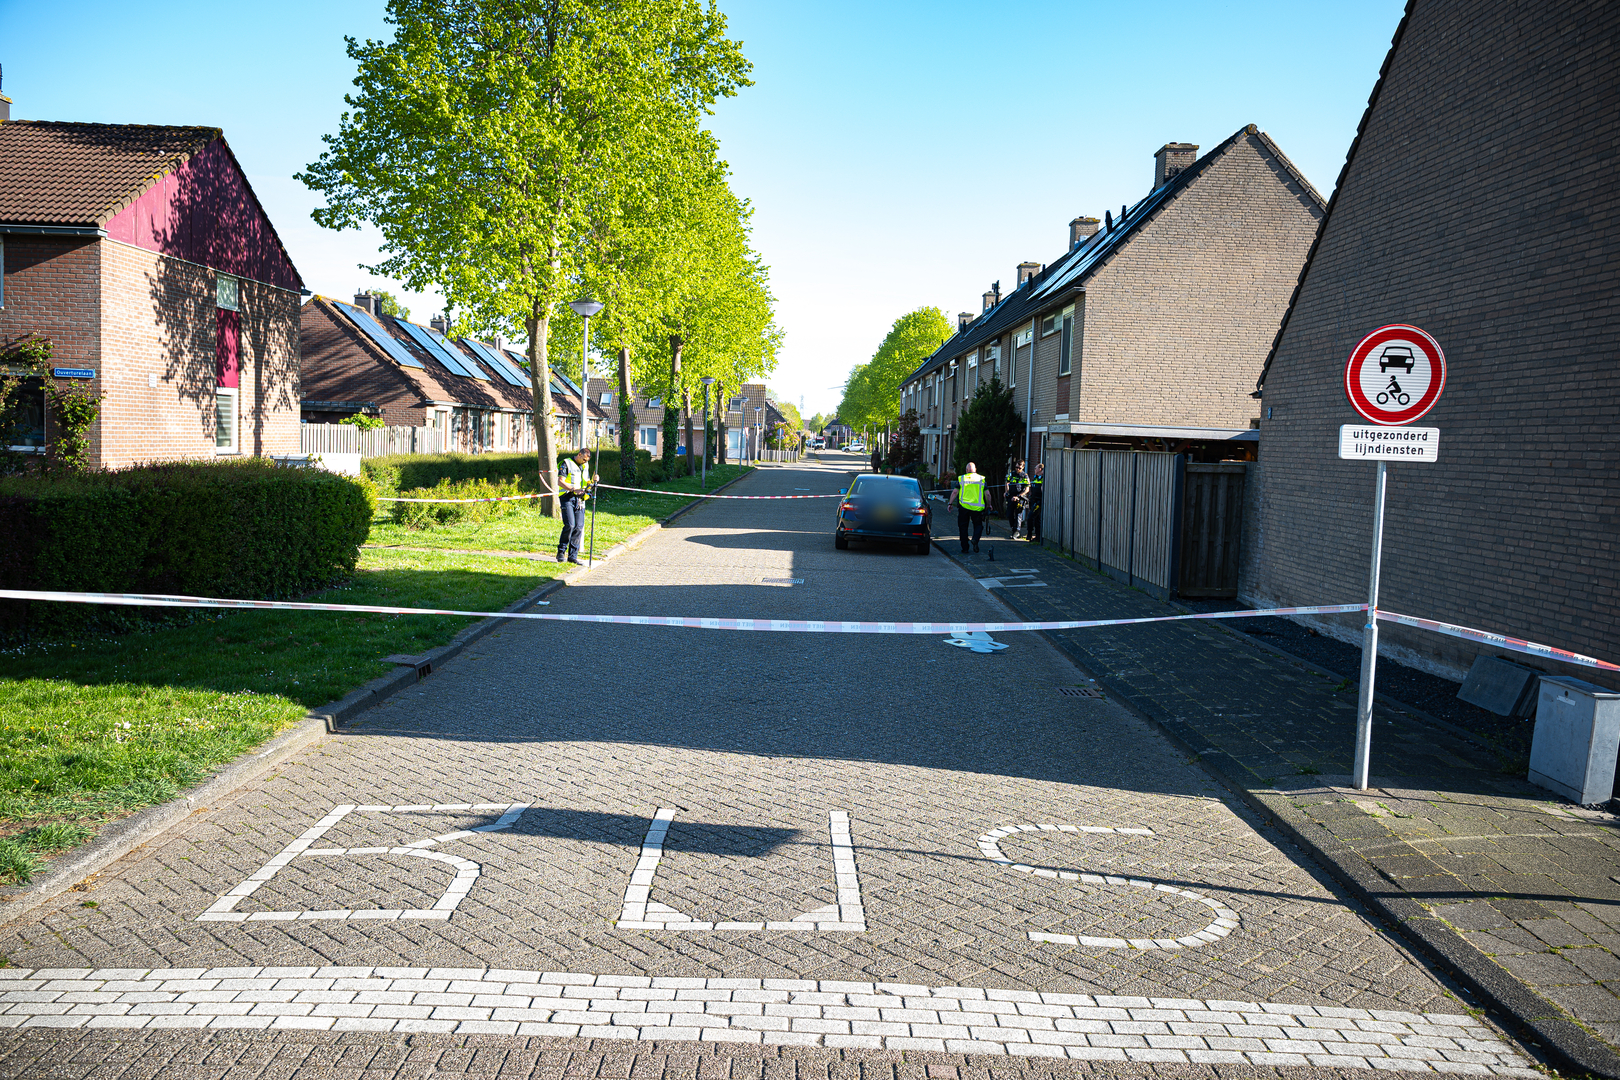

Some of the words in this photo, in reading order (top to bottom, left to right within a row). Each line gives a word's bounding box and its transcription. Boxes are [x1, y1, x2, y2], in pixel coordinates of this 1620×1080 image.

[1353, 429, 1428, 442] uitgezonderd
[1355, 443, 1424, 456] lijndiensten
[195, 802, 1240, 950] BUS
